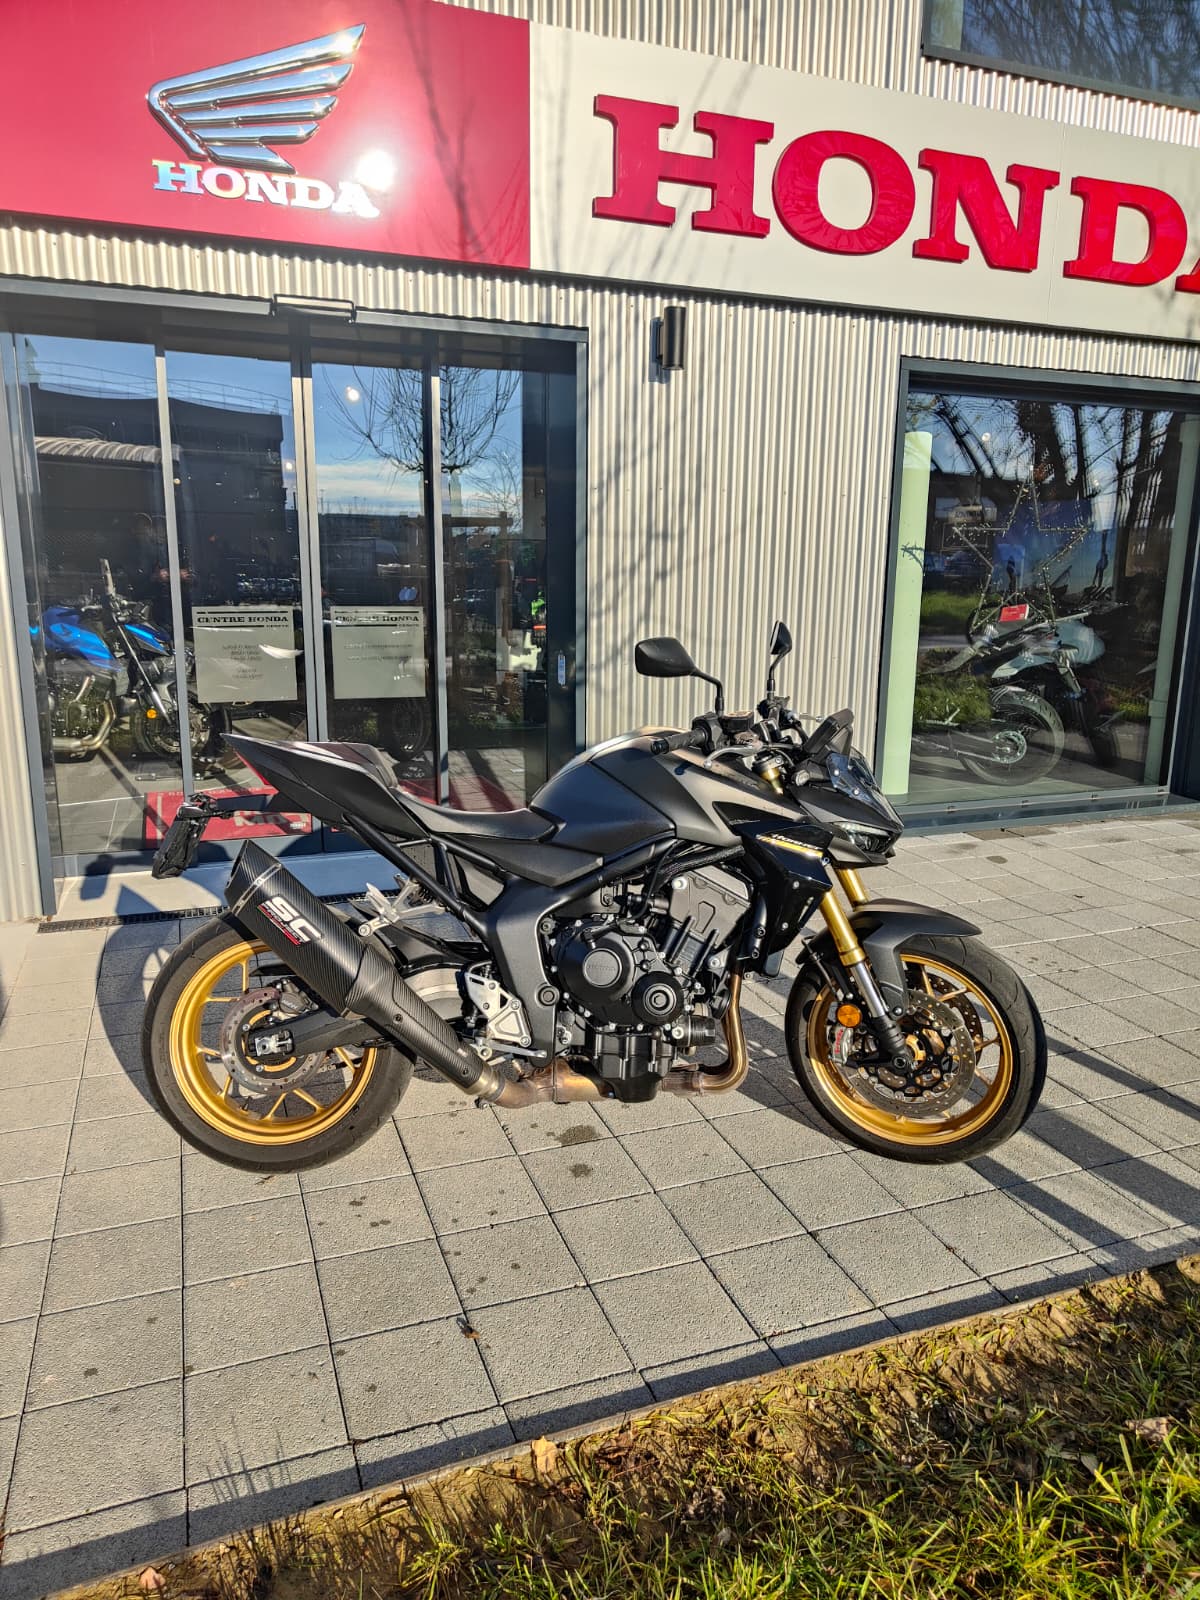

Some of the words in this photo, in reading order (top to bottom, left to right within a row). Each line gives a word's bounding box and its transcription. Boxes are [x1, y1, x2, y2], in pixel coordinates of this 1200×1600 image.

[151, 159, 380, 218] HONDA
[592, 93, 1200, 294] HOND
[264, 896, 322, 942] SC
